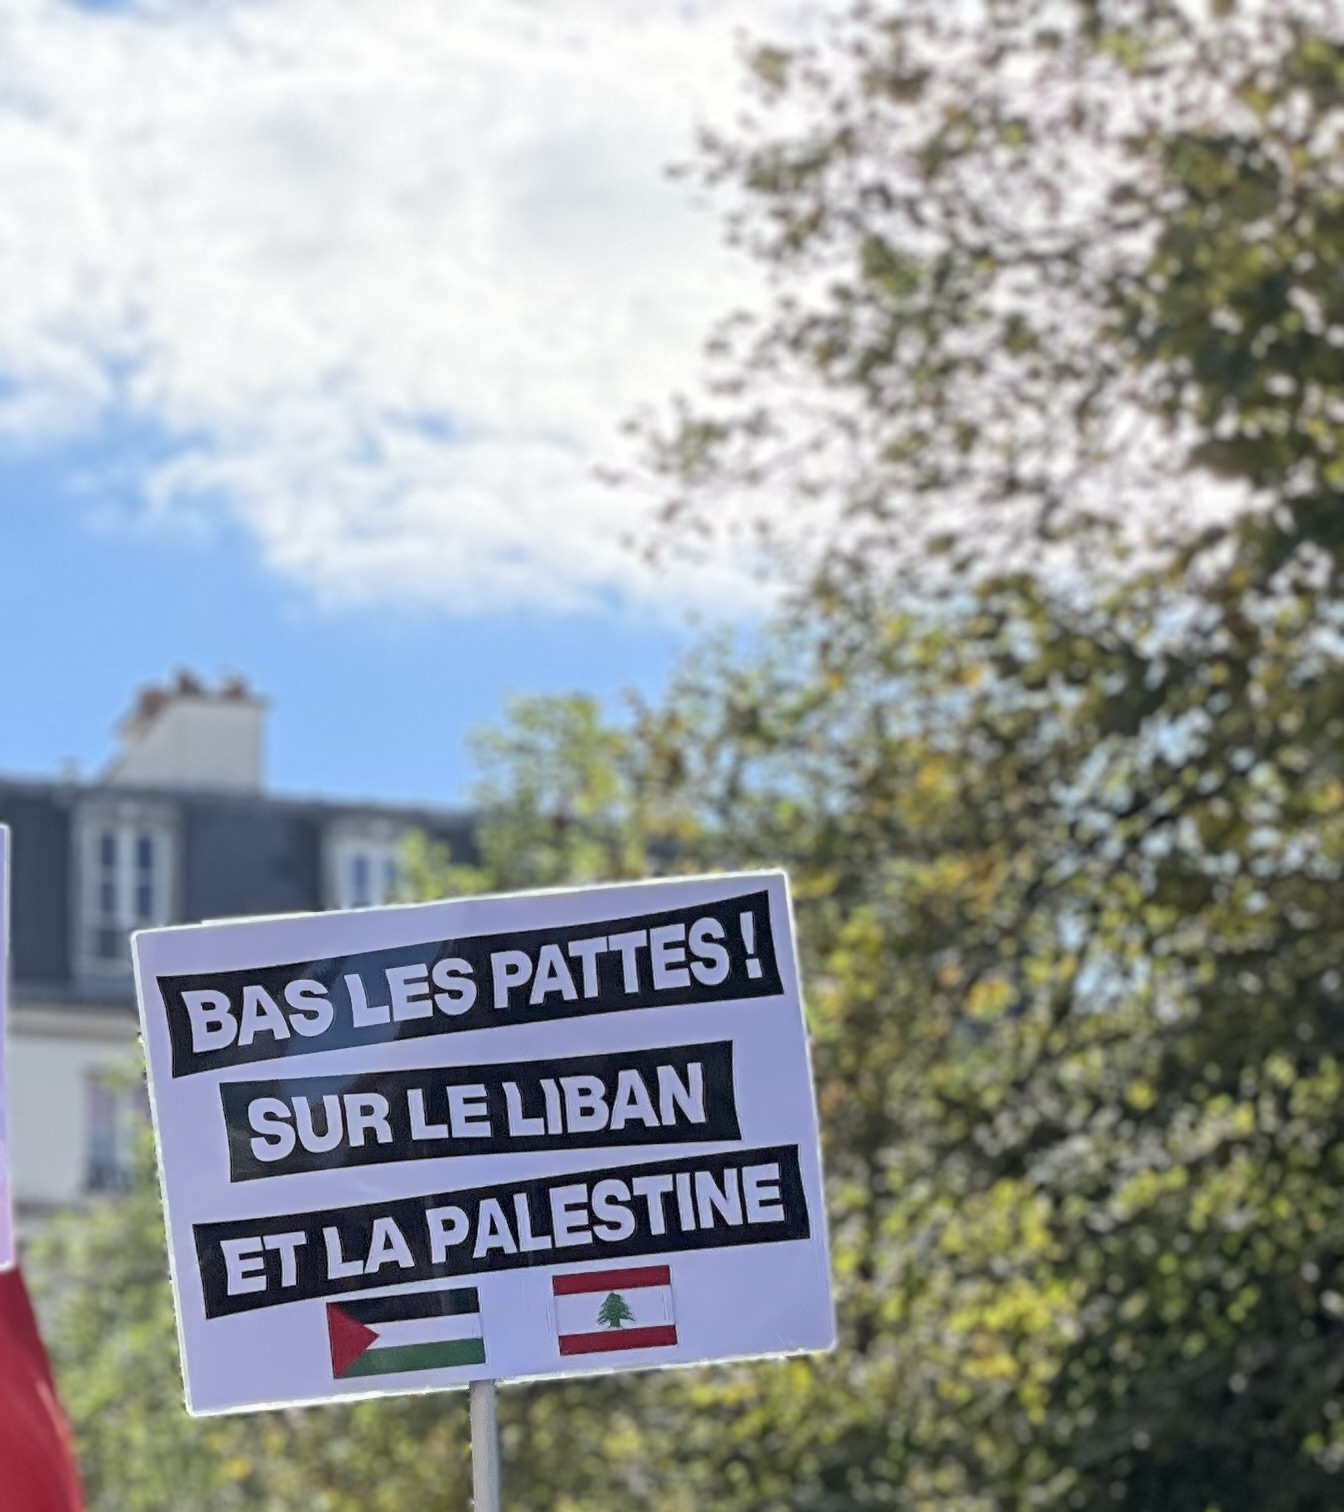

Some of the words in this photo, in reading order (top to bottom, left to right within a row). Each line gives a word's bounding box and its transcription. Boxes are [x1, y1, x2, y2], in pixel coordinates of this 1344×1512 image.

[180, 978, 335, 1053] BAS
[343, 957, 478, 1029] LES
[490, 917, 730, 1009] PATTES
[247, 1092, 394, 1162] SUR
[406, 1083, 492, 1141] LE
[501, 1062, 707, 1137] LIBAN
[219, 1230, 307, 1296] ET
[322, 1216, 416, 1280] LA
[425, 1162, 785, 1265] PALESTINE
